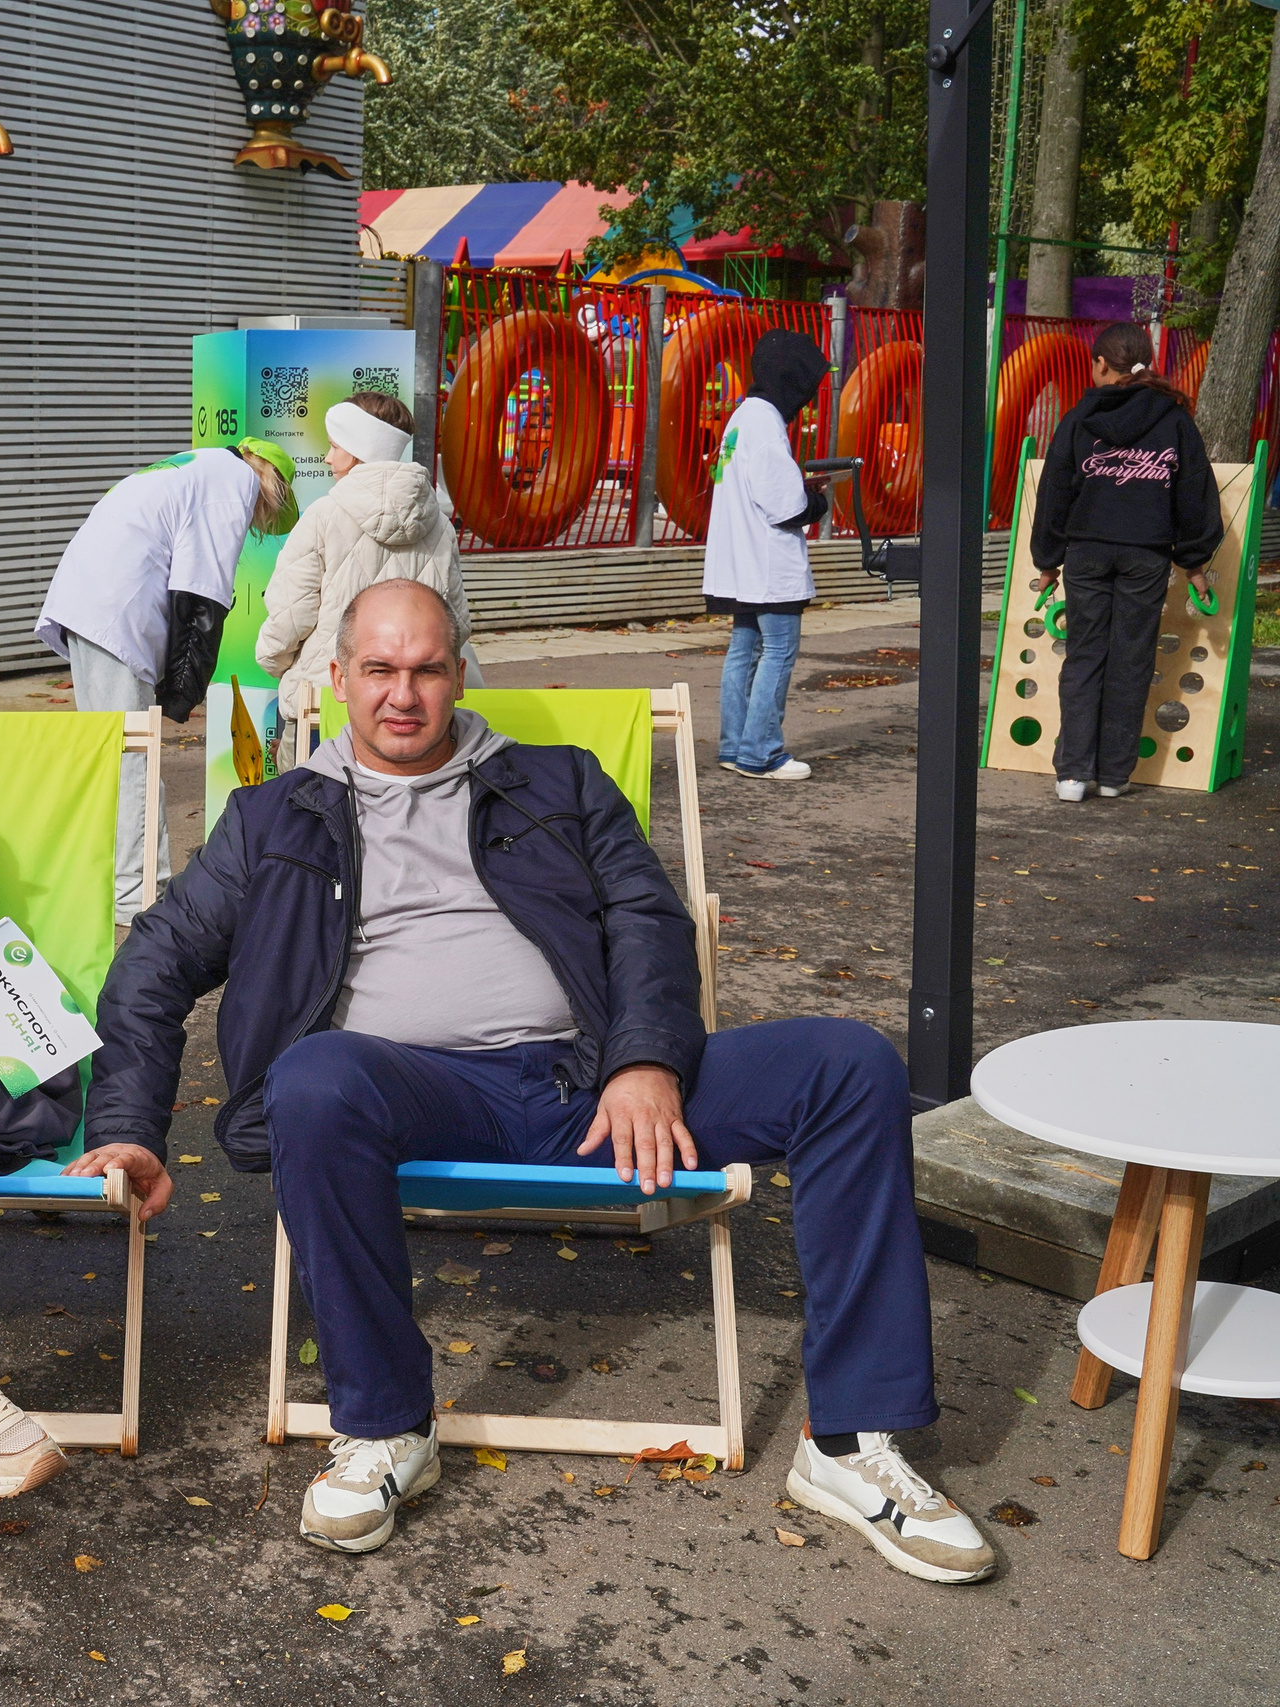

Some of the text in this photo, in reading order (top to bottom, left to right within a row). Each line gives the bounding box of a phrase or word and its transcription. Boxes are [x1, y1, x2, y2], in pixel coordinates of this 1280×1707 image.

[215, 409, 238, 436] 185
[264, 430, 304, 438] ВКонтакте
[295, 470, 325, 479] рьера
[5, 1012, 41, 1054] дня!
